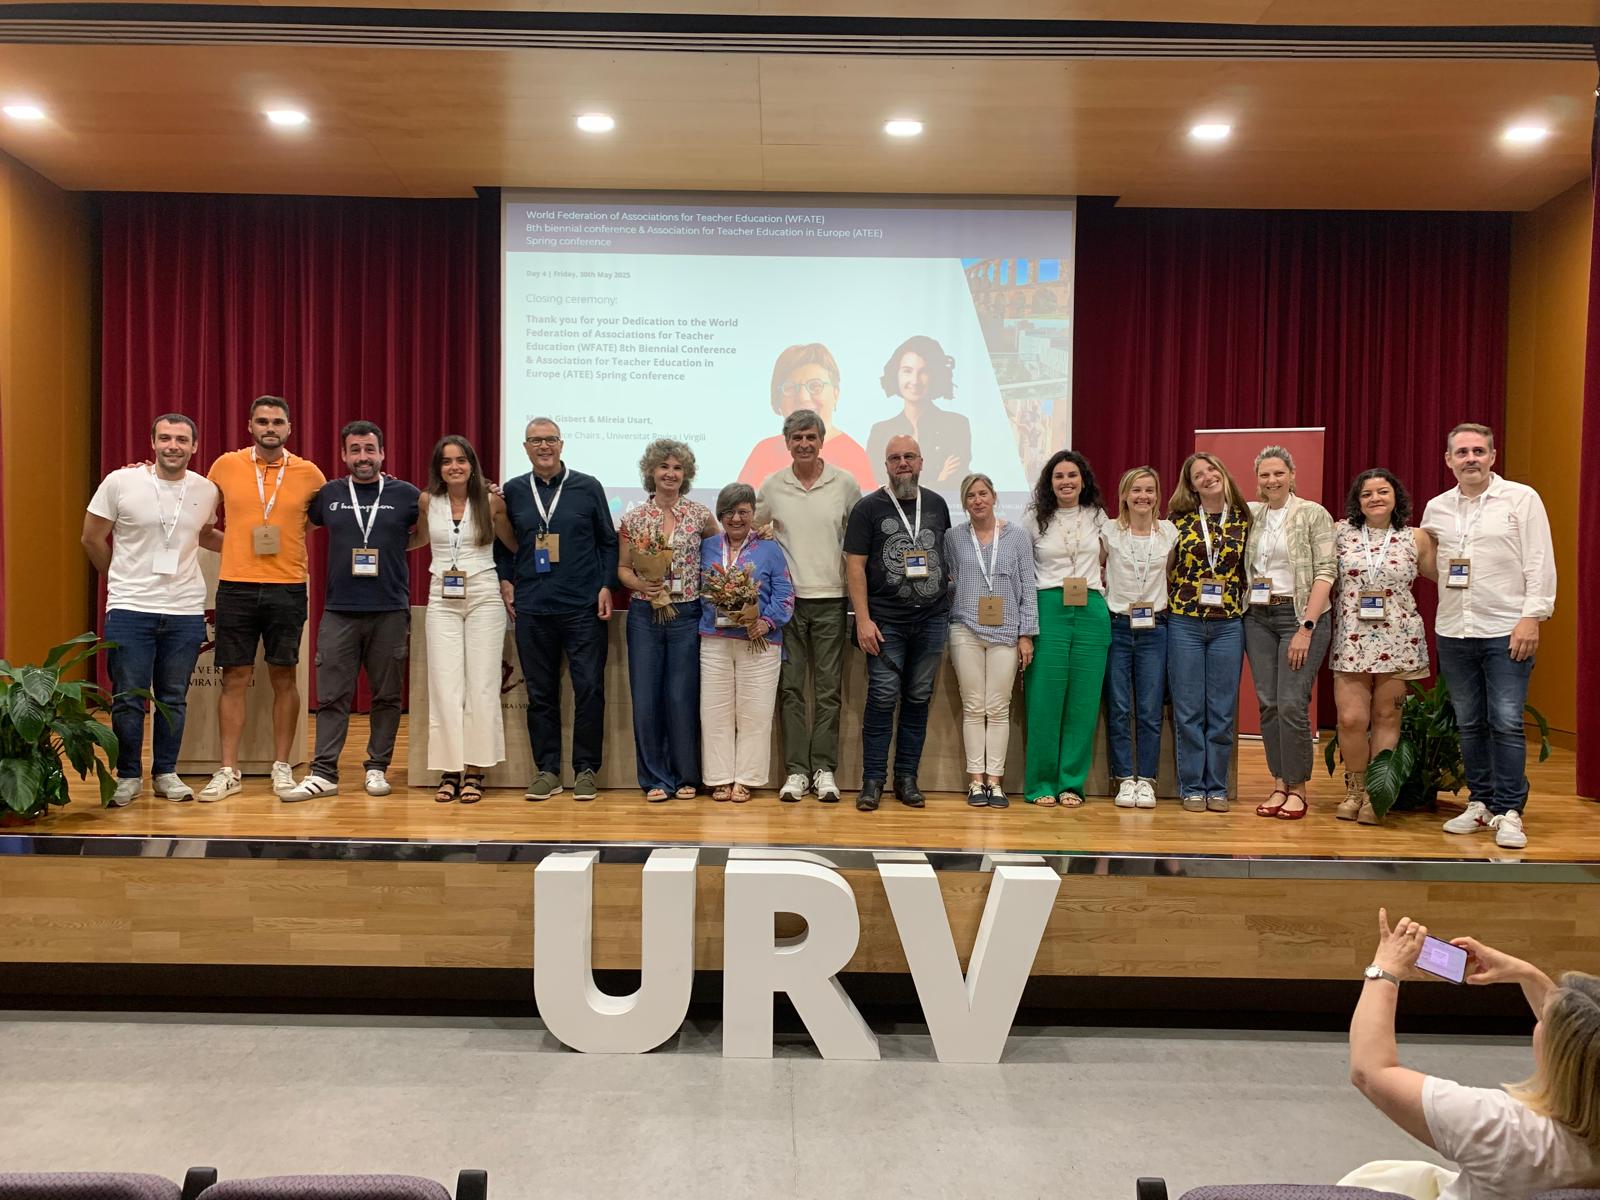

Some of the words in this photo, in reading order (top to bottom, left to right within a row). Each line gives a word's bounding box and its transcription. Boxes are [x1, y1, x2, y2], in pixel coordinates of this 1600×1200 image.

[526, 210, 555, 220] World
[557, 211, 608, 220] Federation
[610, 211, 620, 221] of
[621, 212, 679, 221] Associations
[680, 213, 694, 222] for
[696, 213, 733, 222] Teacher
[735, 214, 782, 223] Education
[785, 214, 825, 225] (WFATE)
[526, 224, 542, 233] 8th
[544, 224, 582, 233] biennial
[583, 224, 637, 234] conference
[639, 225, 645, 234] &
[647, 225, 700, 235] Association
[702, 226, 715, 235] for
[717, 227, 754, 236] Teacher
[756, 227, 803, 237] Education
[805, 228, 814, 237] in
[817, 228, 850, 239] Europe
[852, 228, 883, 239] (ATEE)
[526, 237, 557, 248] Spring
[559, 237, 612, 247] conference
[541, 270, 547, 278] 4
[526, 294, 563, 305] Closing
[565, 295, 618, 306] ceremony:
[526, 315, 557, 325] Thank
[559, 317, 577, 327] you
[580, 315, 595, 325] for
[596, 318, 620, 327] your
[622, 316, 675, 326] Dedication
[677, 318, 688, 326] to
[690, 317, 707, 327] the
[708, 317, 738, 327] World
[526, 328, 580, 338] Federation
[582, 329, 592, 338] of
[594, 329, 656, 339] Associations
[658, 330, 673, 340] for
[675, 331, 715, 340] Teacher
[526, 342, 575, 352] Education
[577, 342, 617, 353] (WFATE)
[619, 343, 636, 353] 8th
[638, 344, 679, 354] Biennial
[681, 344, 737, 355] Conference
[526, 356, 533, 365] &
[535, 356, 593, 366] Association
[595, 357, 610, 366] for
[612, 357, 651, 367] Teacher
[653, 358, 702, 368] Education
[704, 359, 714, 368] in
[526, 369, 560, 380] Europe
[563, 370, 594, 380] (ATEE)
[595, 370, 627, 382] Spring
[629, 370, 685, 381] Conference
[555, 415, 587, 424] Gisbert
[588, 415, 596, 424] &
[597, 415, 625, 424] Mireia
[627, 416, 653, 426] Usart,
[684, 433, 706, 443] Virgili
[329, 501, 395, 513] Champon
[534, 856, 1062, 1063] URV
